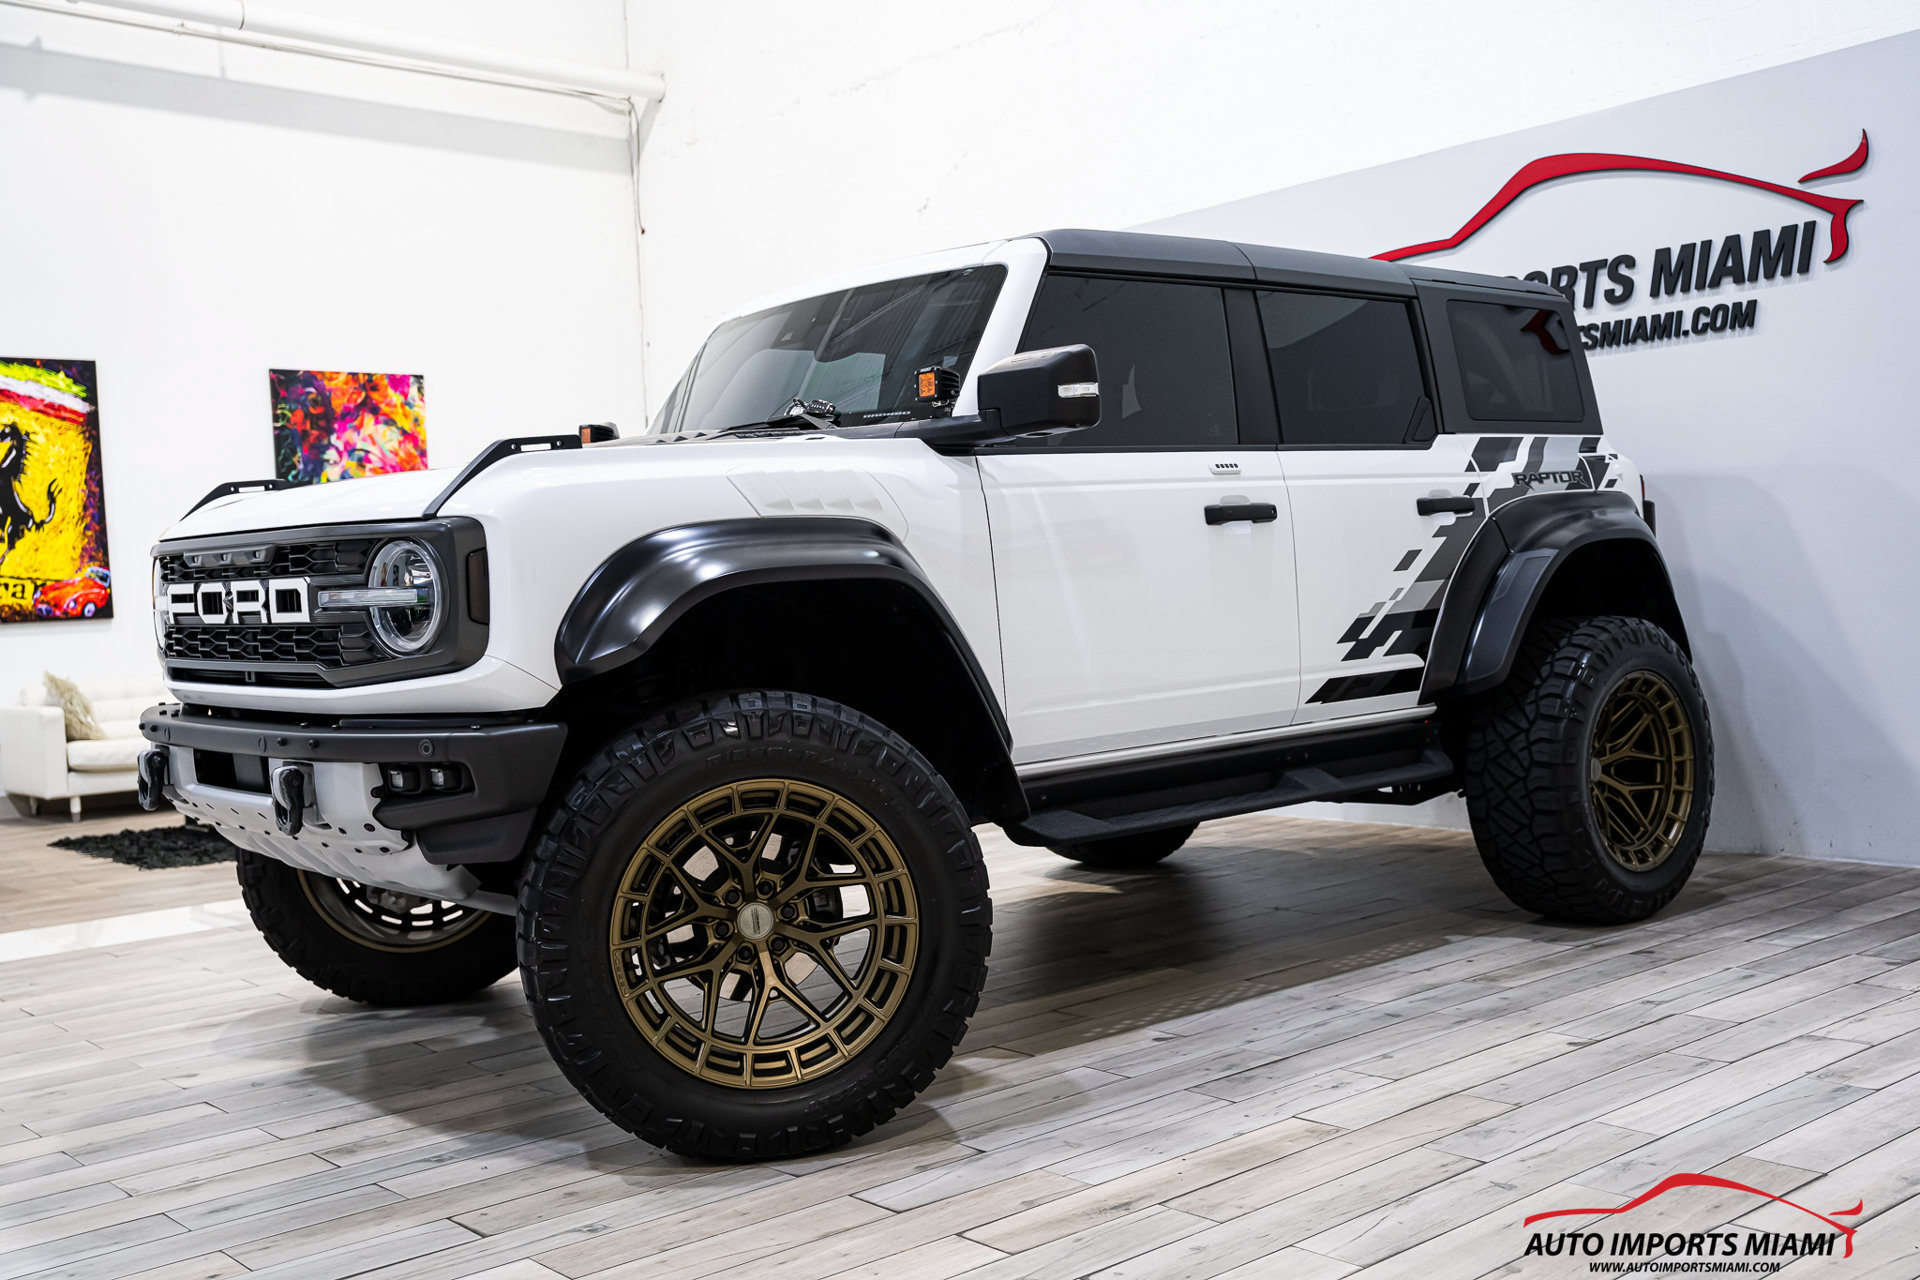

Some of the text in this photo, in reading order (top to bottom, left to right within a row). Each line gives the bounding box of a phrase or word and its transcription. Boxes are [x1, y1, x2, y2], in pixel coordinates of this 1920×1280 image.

[1505, 220, 1816, 310] RTS MIAMI
[1511, 470, 1590, 491] RAPTOR
[167, 577, 311, 624] FORD
